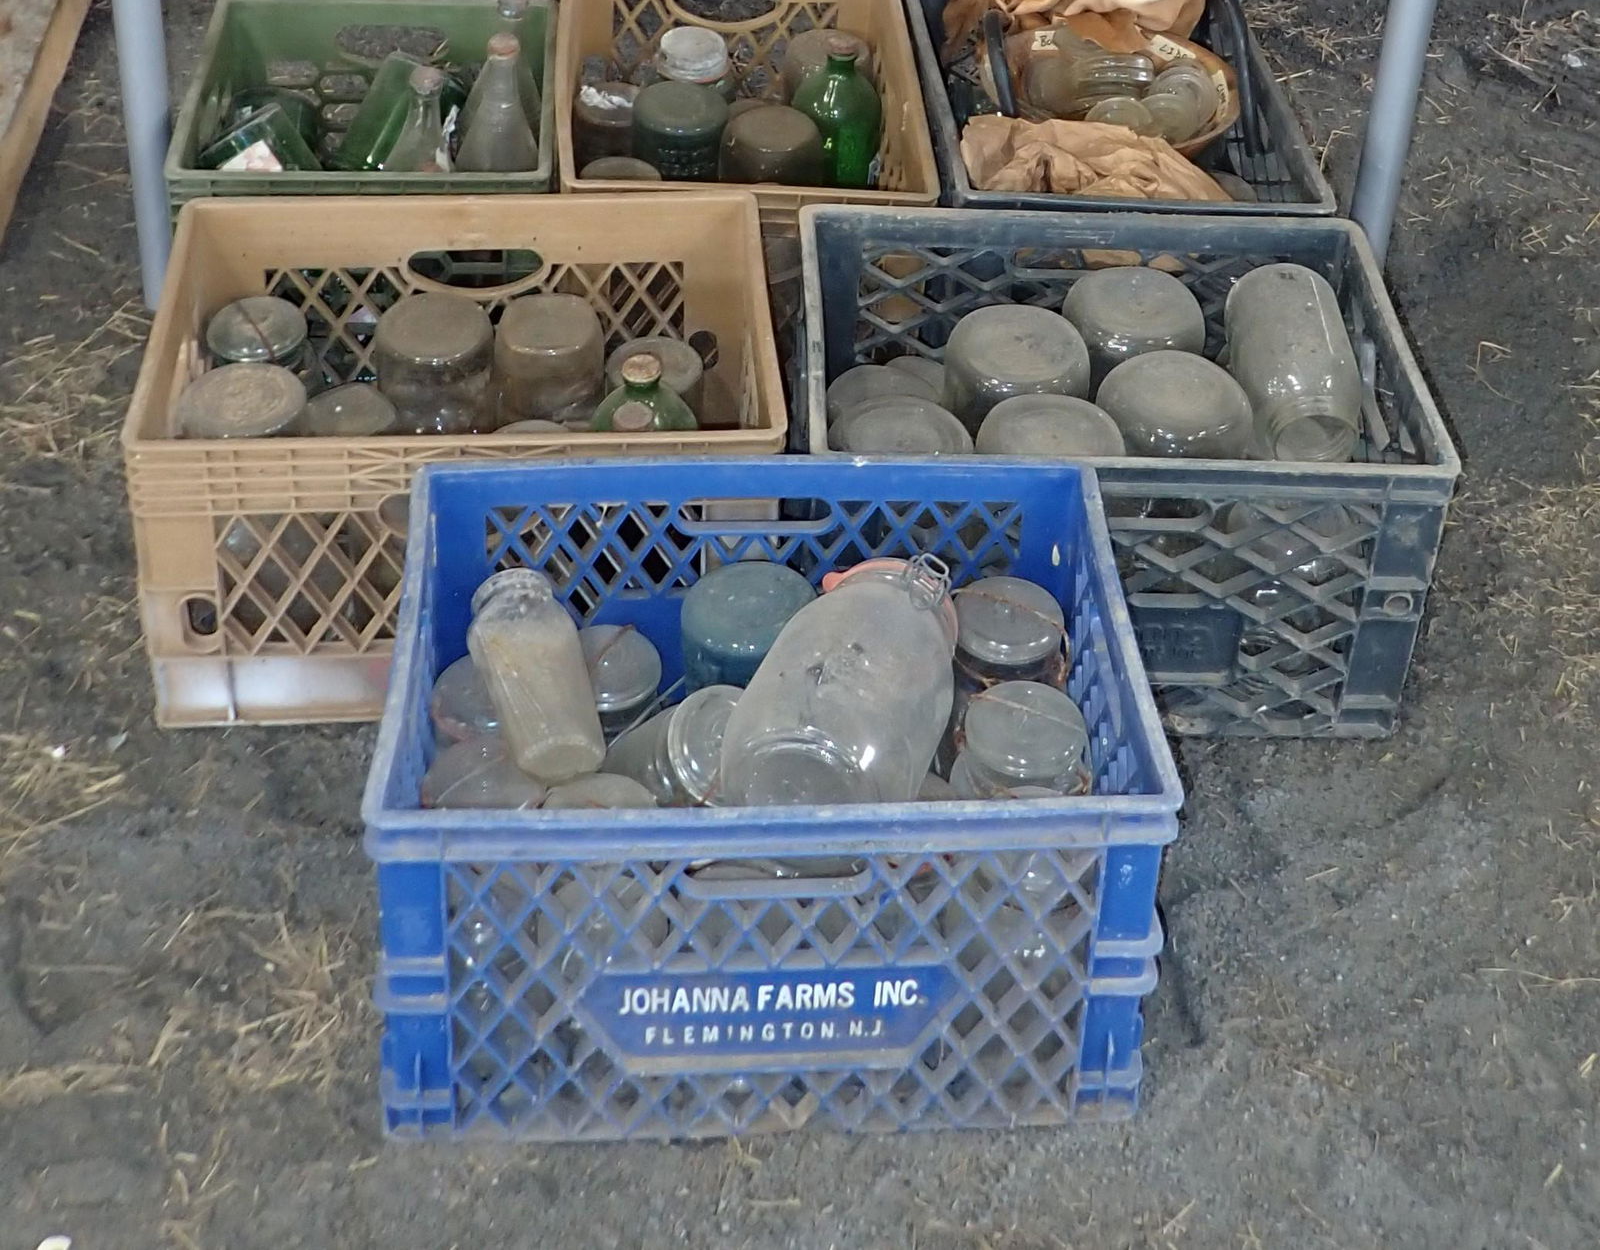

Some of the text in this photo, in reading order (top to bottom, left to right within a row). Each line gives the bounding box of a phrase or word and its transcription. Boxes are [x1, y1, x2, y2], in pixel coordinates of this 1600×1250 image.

[619, 979, 927, 1015] JOHANNA FARMS INC.
